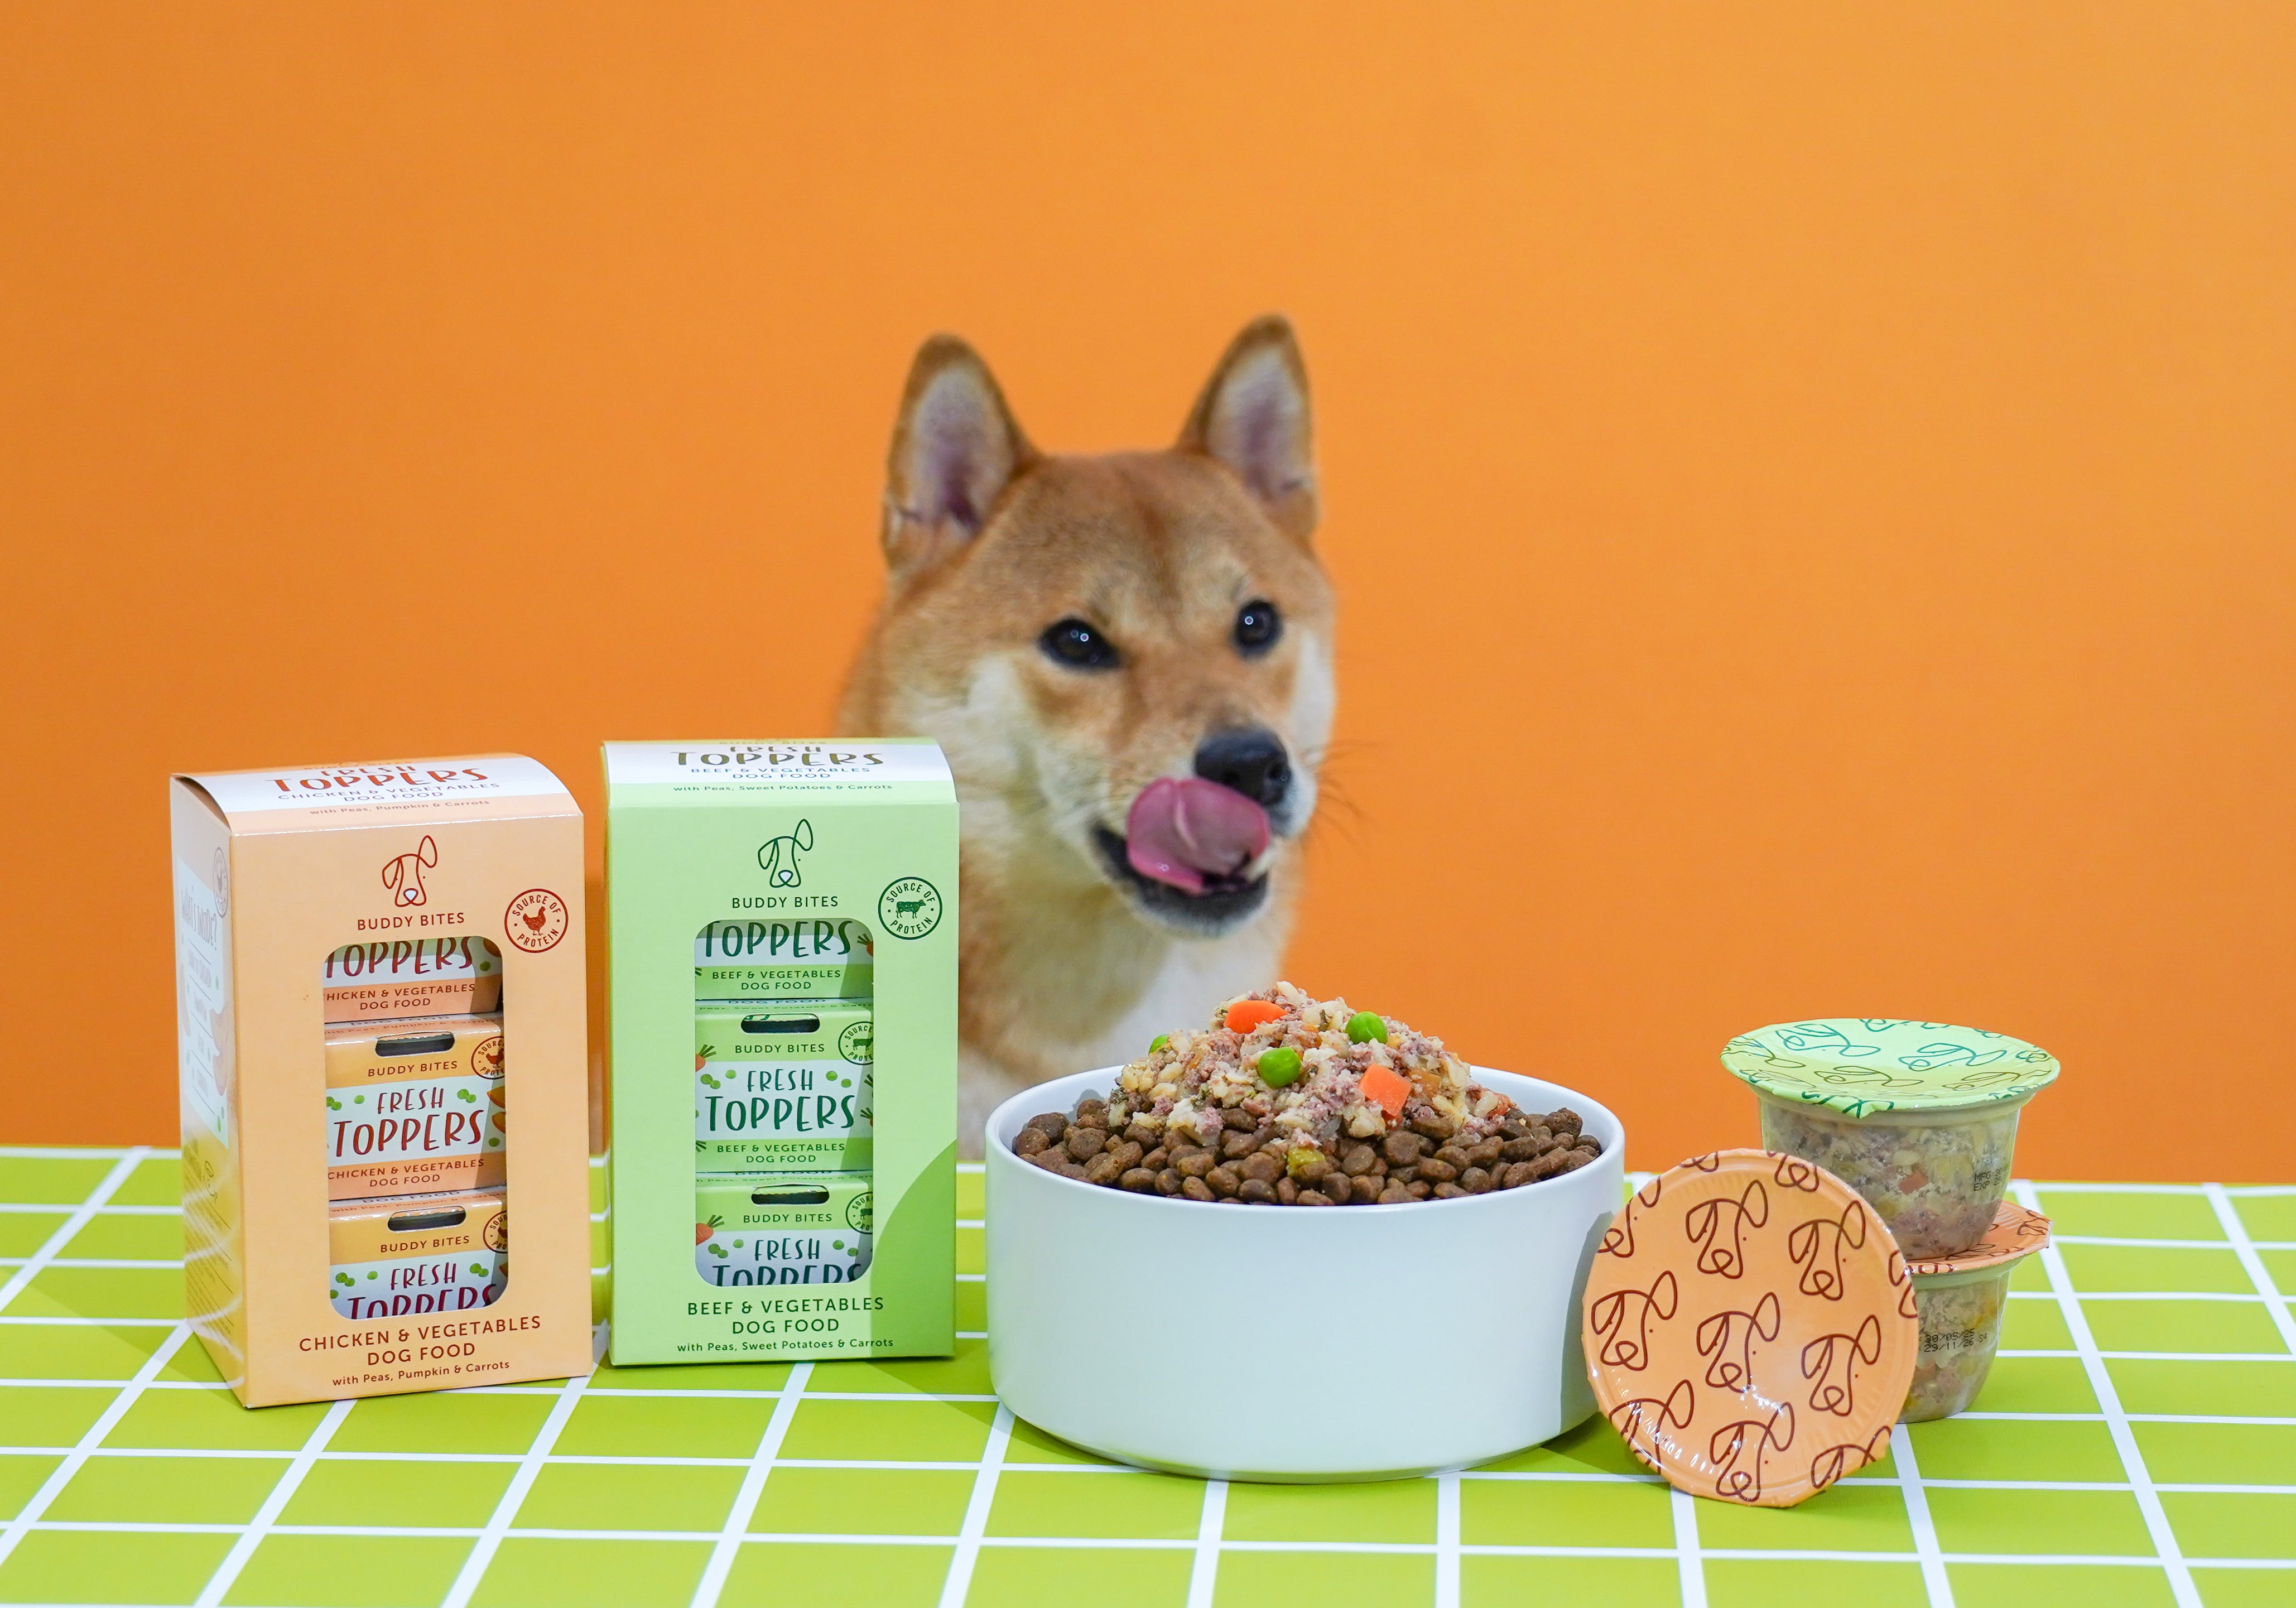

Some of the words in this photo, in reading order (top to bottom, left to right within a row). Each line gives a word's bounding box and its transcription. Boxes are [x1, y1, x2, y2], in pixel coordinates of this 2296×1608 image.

[671, 752, 884, 766] TOPPERS
[266, 768, 488, 792] TOPPERS
[278, 790, 361, 800] CHICKEN
[386, 783, 500, 793] VEGETABLES
[732, 897, 787, 908] BUDDY
[795, 896, 838, 907] BITES
[886, 883, 922, 903] SOURCE
[923, 891, 936, 902] OF
[512, 894, 548, 916] SOURCE
[550, 902, 561, 913] OF
[357, 916, 413, 930] BUDDY
[420, 912, 465, 926] BITES
[890, 917, 933, 935] PROTEIN
[517, 928, 559, 947] PROTEIN
[705, 921, 853, 957] TOPPERS
[326, 936, 473, 978] TOPPERS
[760, 970, 841, 979] VEGETABLES
[323, 990, 376, 1002] HICKEN
[382, 989, 389, 998] &
[394, 983, 475, 996] VEGETABLES
[741, 982, 769, 990] DOG
[776, 981, 812, 990] FOOD
[360, 1000, 389, 1010] DOG
[394, 998, 431, 1008] FOOD
[478, 1040, 504, 1055] SOURC
[735, 1044, 781, 1053] BUDDY
[787, 1043, 825, 1052] BITES
[848, 1051, 873, 1062] PROTE
[368, 1065, 415, 1077] BUDDY
[420, 1061, 458, 1072] BITES
[747, 1068, 813, 1092] FRESH
[377, 1087, 444, 1114] FRESH
[705, 1095, 855, 1132] TOPPERS
[334, 1110, 484, 1157] TOPPERS
[765, 1143, 845, 1152] VEGETABLES
[328, 1167, 386, 1180] CHICKEN
[404, 1159, 484, 1173] VEGETABLES
[369, 1177, 398, 1187] DOG
[403, 1174, 440, 1185] FOOD
[1973, 1180, 1990, 1191] EXP
[409, 1191, 460, 1199] FOOD
[852, 1196, 873, 1210] SOUR
[490, 1214, 507, 1230] SOUR
[744, 1214, 790, 1223] BUDDY
[795, 1214, 832, 1222] BITES
[381, 1240, 427, 1253] BUDDY
[433, 1235, 470, 1248] BITES
[755, 1238, 820, 1261] FRESH
[391, 1262, 456, 1290] FRESH
[688, 1302, 733, 1315] BEEF
[742, 1301, 753, 1314] &
[761, 1297, 884, 1313] VEGETABLES
[299, 1330, 389, 1352] CHICKEN
[398, 1328, 410, 1342] &
[418, 1316, 541, 1340] VEGETABLES
[733, 1321, 776, 1334] DOG
[784, 1318, 839, 1332] FOOD
[367, 1348, 411, 1366] DOG
[420, 1342, 475, 1360] FOOD
[677, 1342, 703, 1352] with
[707, 1342, 738, 1351] Peas,
[742, 1341, 777, 1350] Sweet
[782, 1340, 833, 1349] Potatoes
[838, 1339, 845, 1348] &
[850, 1338, 893, 1347] Carrots
[333, 1375, 359, 1386] with
[363, 1373, 393, 1383] Peas,
[398, 1366, 450, 1380] Pumpkin
[454, 1365, 461, 1374] &
[466, 1361, 510, 1373] Carrots
